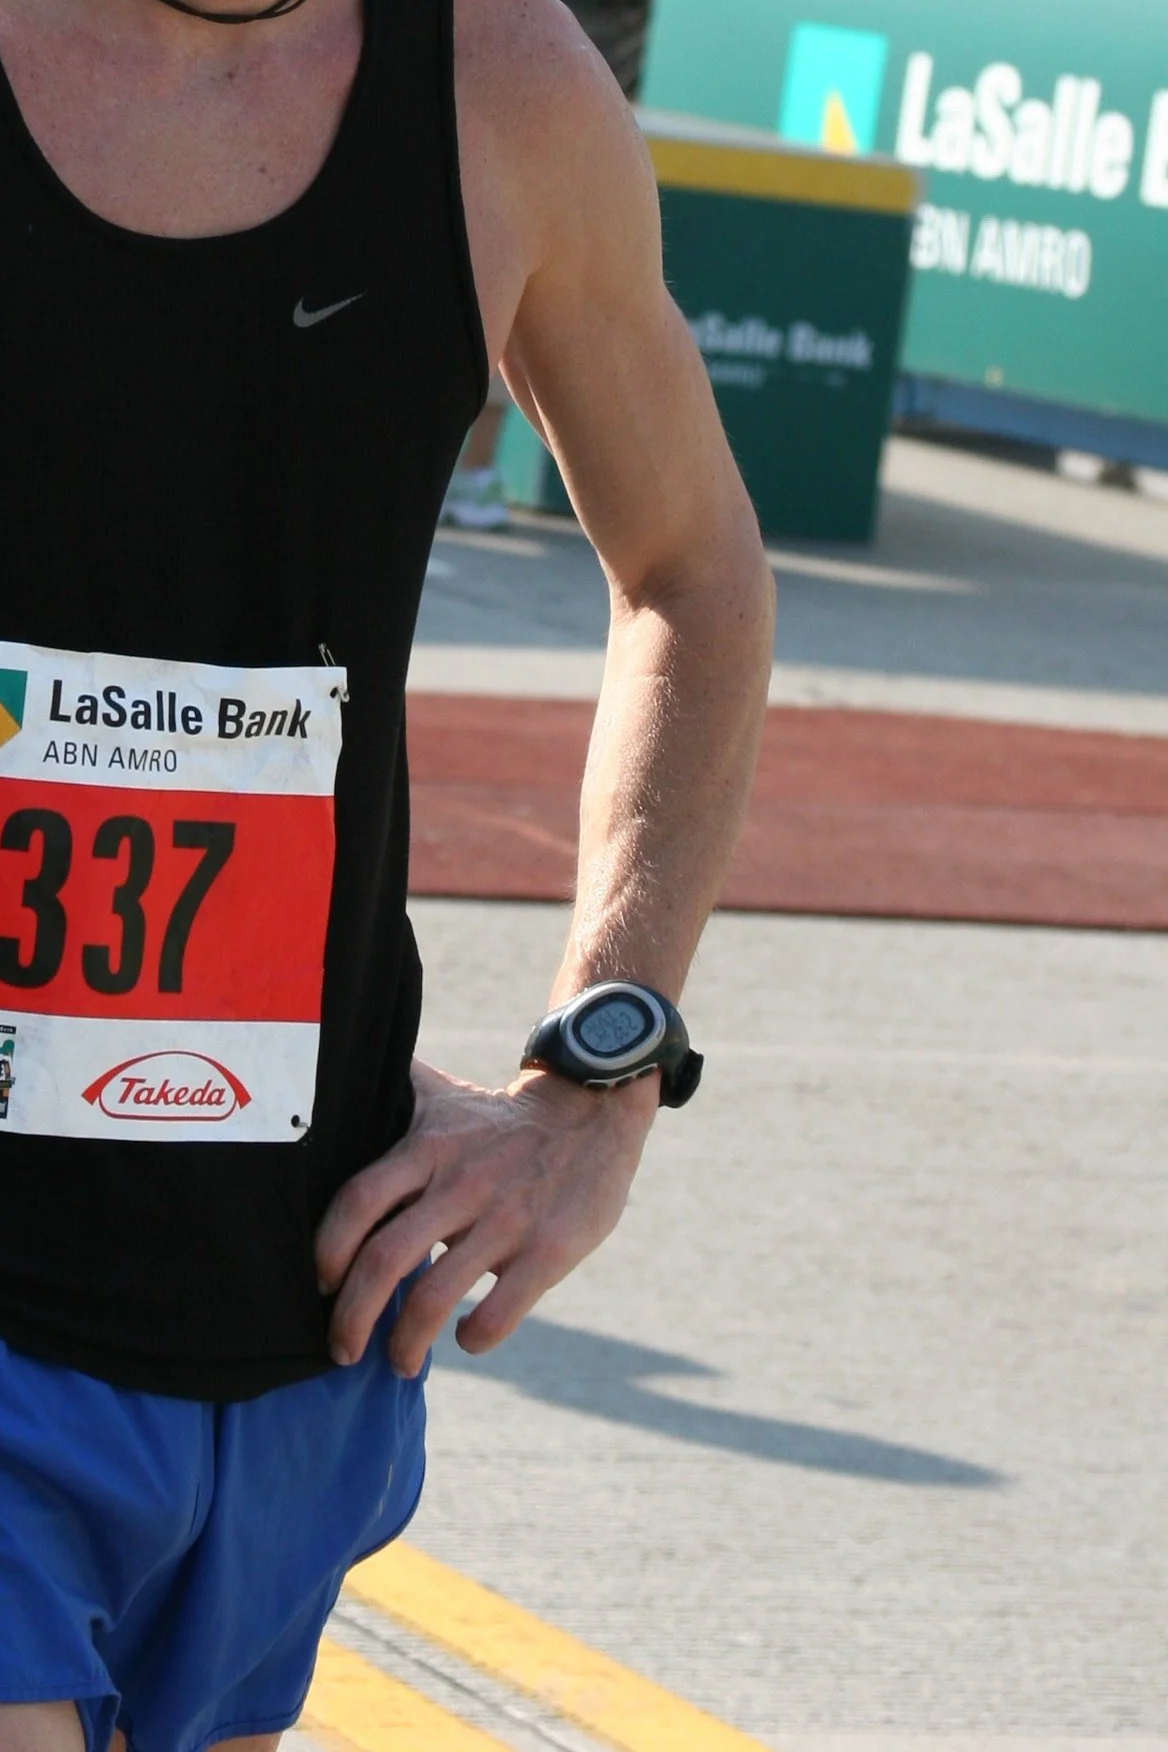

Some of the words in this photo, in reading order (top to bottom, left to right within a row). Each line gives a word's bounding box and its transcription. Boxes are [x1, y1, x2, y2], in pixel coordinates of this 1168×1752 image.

[895, 51, 1133, 200] LaSalle
[971, 214, 1091, 298] AMRO
[48, 679, 203, 736] LaSalle
[217, 697, 312, 740] Bank
[43, 740, 98, 768] ABN
[108, 746, 178, 773] AMRO
[118, 1076, 226, 1107] Takeda
